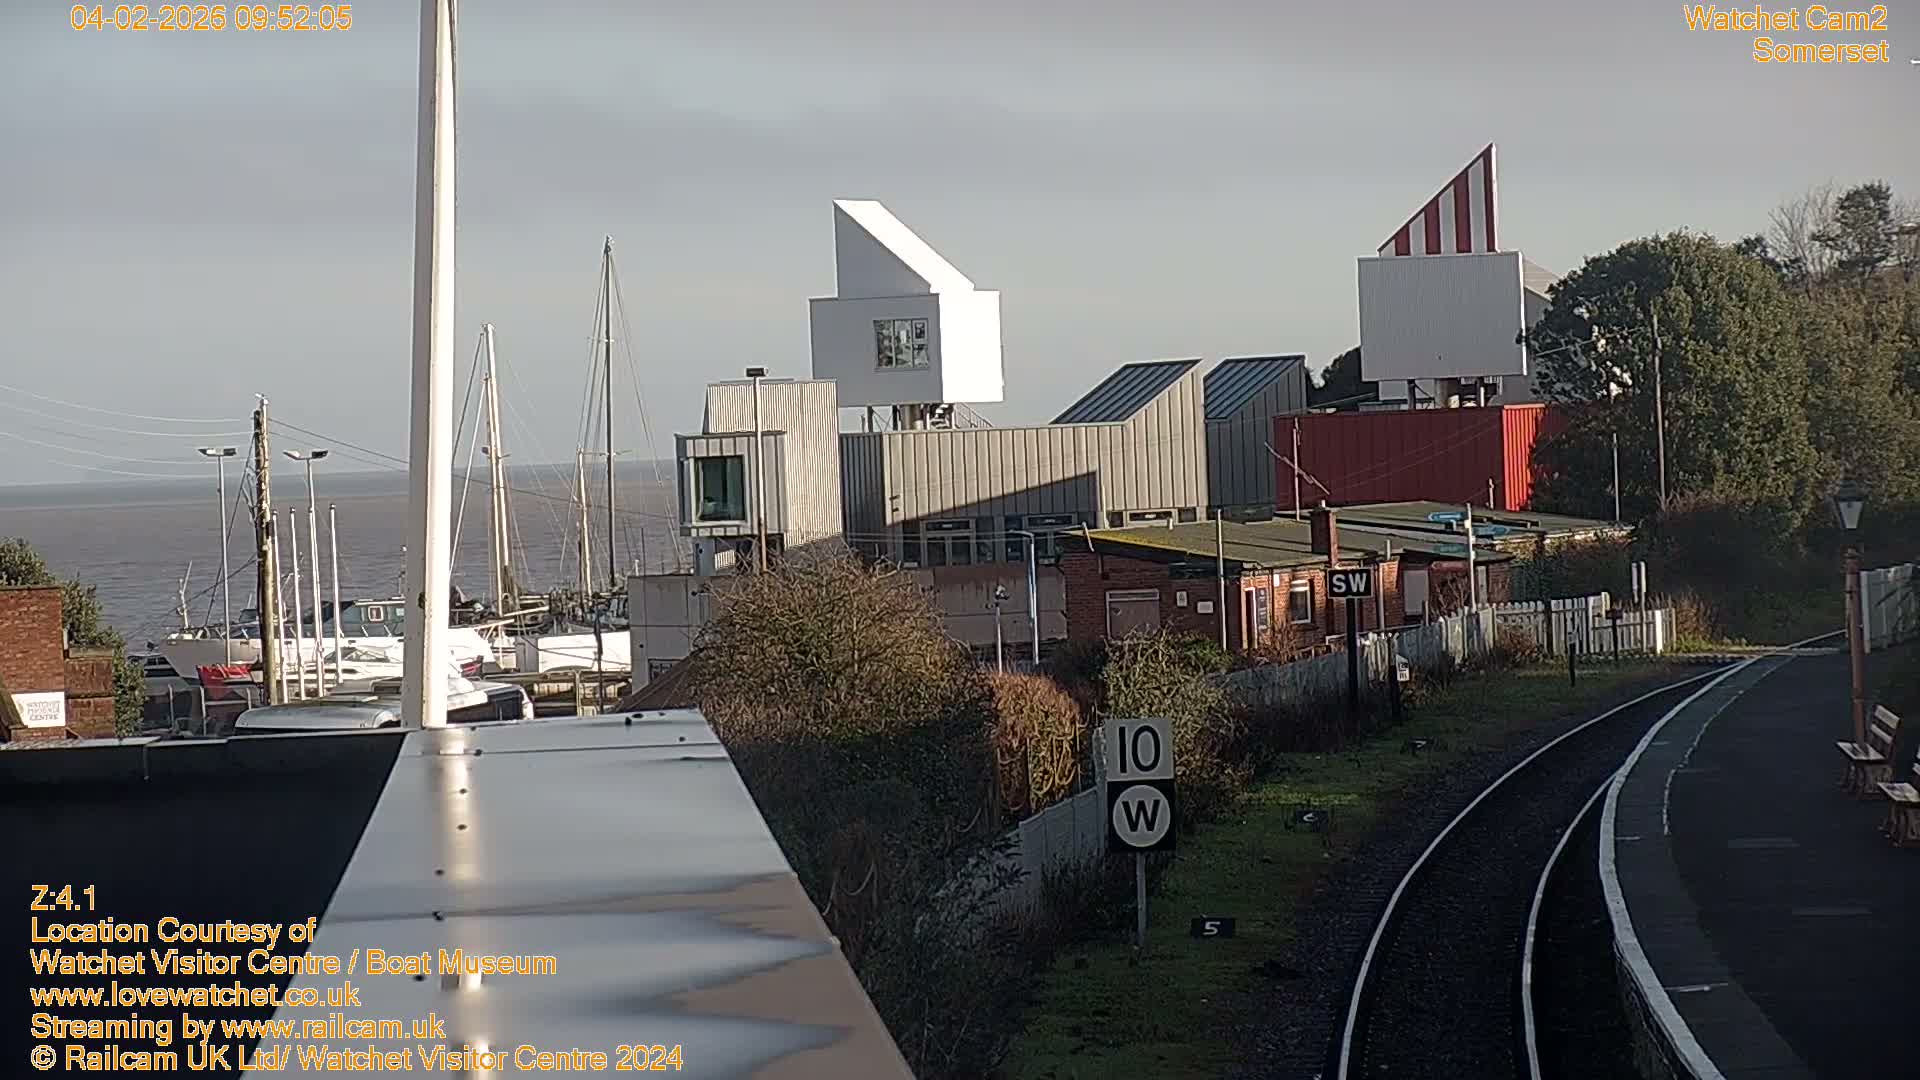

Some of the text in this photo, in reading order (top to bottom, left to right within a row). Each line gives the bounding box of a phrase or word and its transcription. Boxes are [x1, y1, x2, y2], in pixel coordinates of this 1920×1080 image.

[1332, 573, 1367, 593] SW
[1118, 724, 1161, 774] 10
[1121, 799, 1161, 833] W
[1203, 921, 1221, 936] 5
